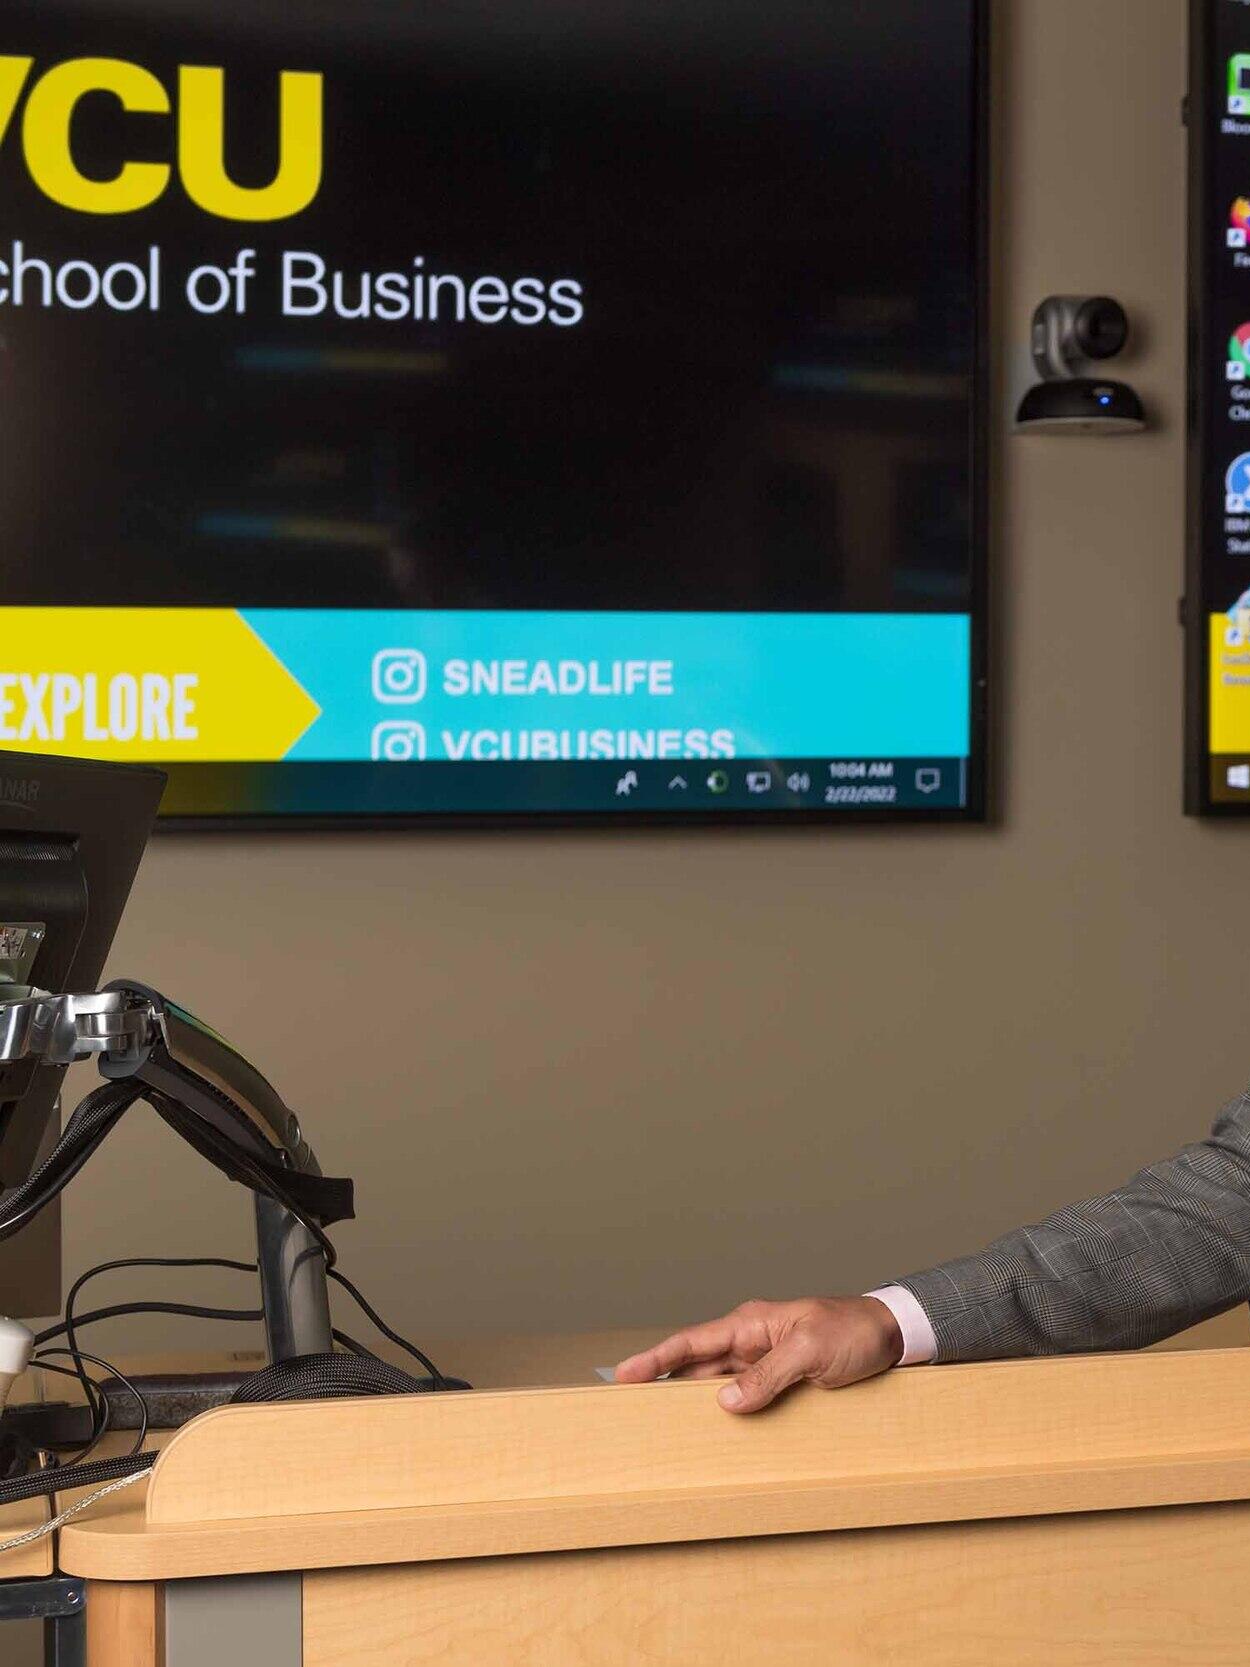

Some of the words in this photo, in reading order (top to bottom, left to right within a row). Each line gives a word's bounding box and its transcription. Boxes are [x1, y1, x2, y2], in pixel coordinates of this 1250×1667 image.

[0, 55, 323, 221] CU
[0, 240, 160, 311] hool
[185, 249, 257, 314] of
[282, 251, 584, 326] Business
[442, 659, 674, 695] SNEADLIFE
[0, 673, 198, 741] EXPLORE
[441, 729, 735, 760] VCUBUSINESS
[868, 762, 894, 779] AM
